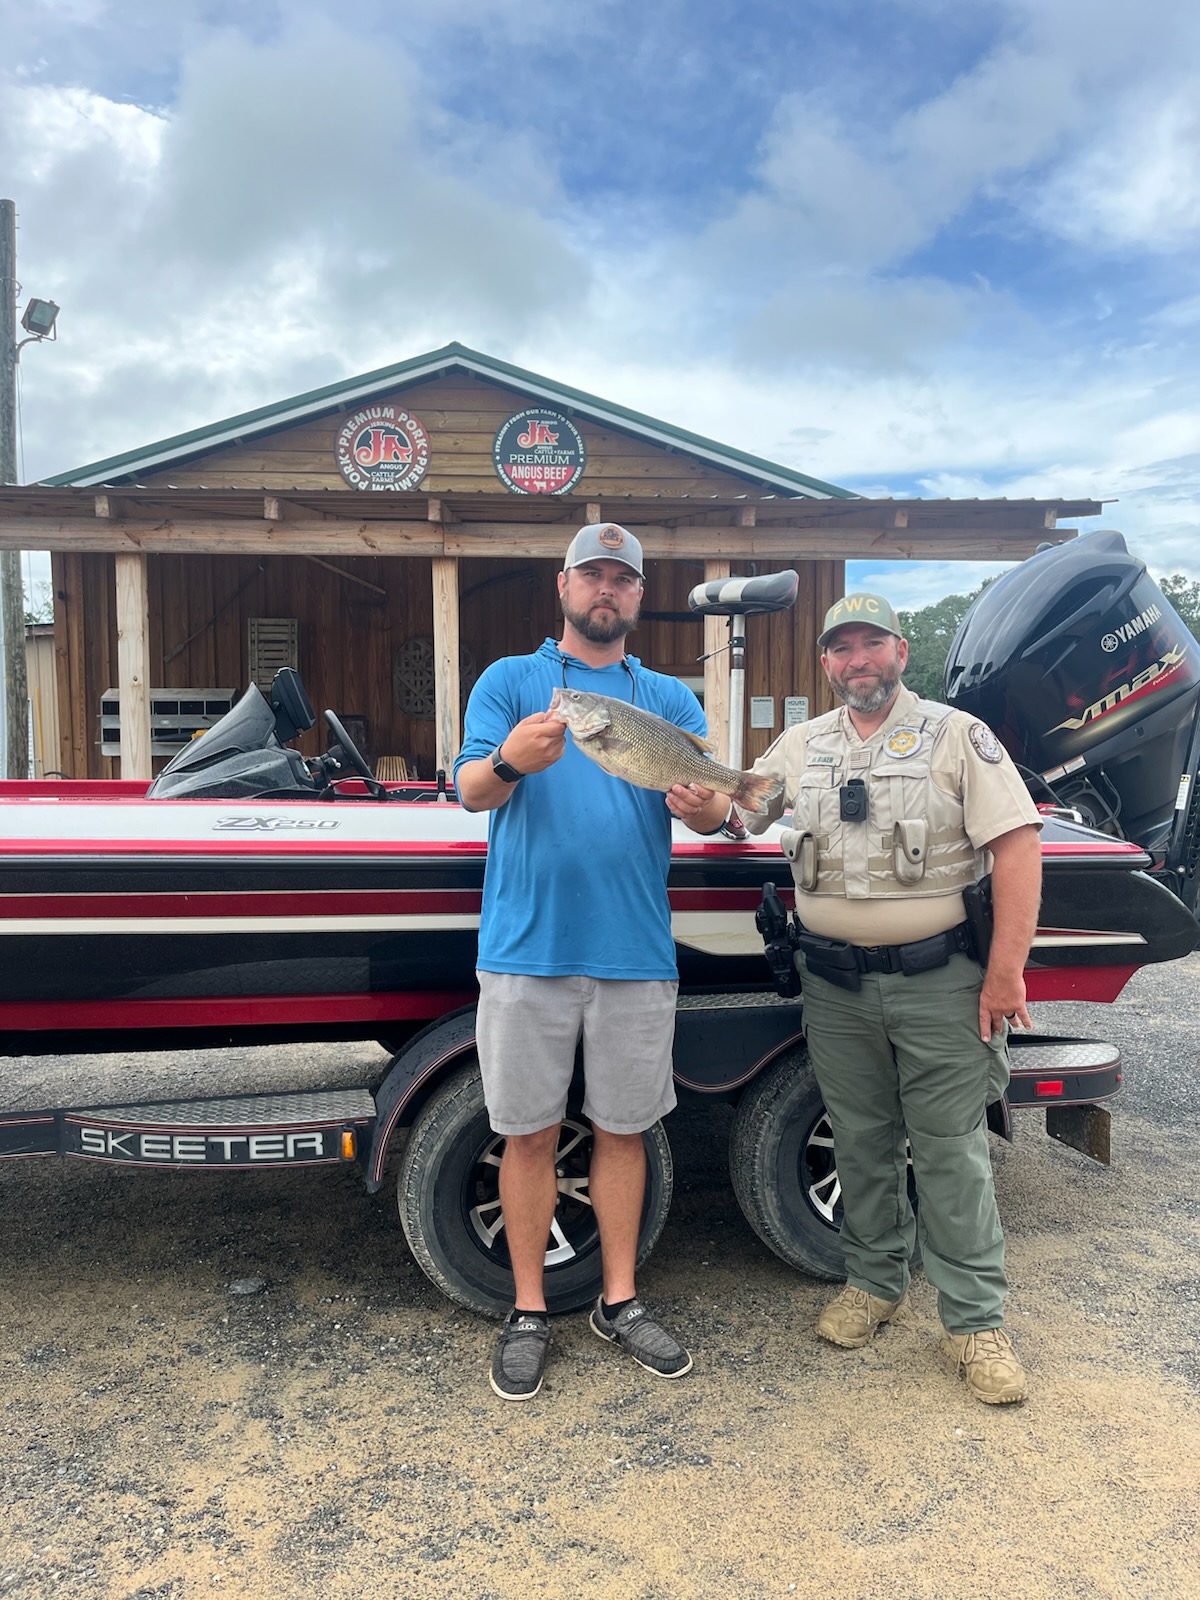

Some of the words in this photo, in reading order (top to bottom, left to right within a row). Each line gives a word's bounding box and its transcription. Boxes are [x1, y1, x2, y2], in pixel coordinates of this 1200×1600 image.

[339, 407, 395, 446] PREMIUM
[397, 412, 428, 449] PORK
[509, 412, 525, 425] FROM
[540, 409, 557, 417] FARM
[557, 414, 566, 422] TO
[565, 420, 579, 436] YOUR
[575, 434, 584, 455] TABLE
[517, 420, 559, 448] JA
[355, 429, 413, 467] JA
[509, 454, 569, 465] PREMIUM
[339, 454, 369, 490] PORK
[511, 465, 543, 479] ANGUS
[543, 466, 567, 480] BEEF
[833, 597, 880, 621] FWC
[1115, 603, 1162, 643] YAMAHA
[212, 815, 340, 831] ZX250
[81, 1128, 323, 1160] SKEETER
